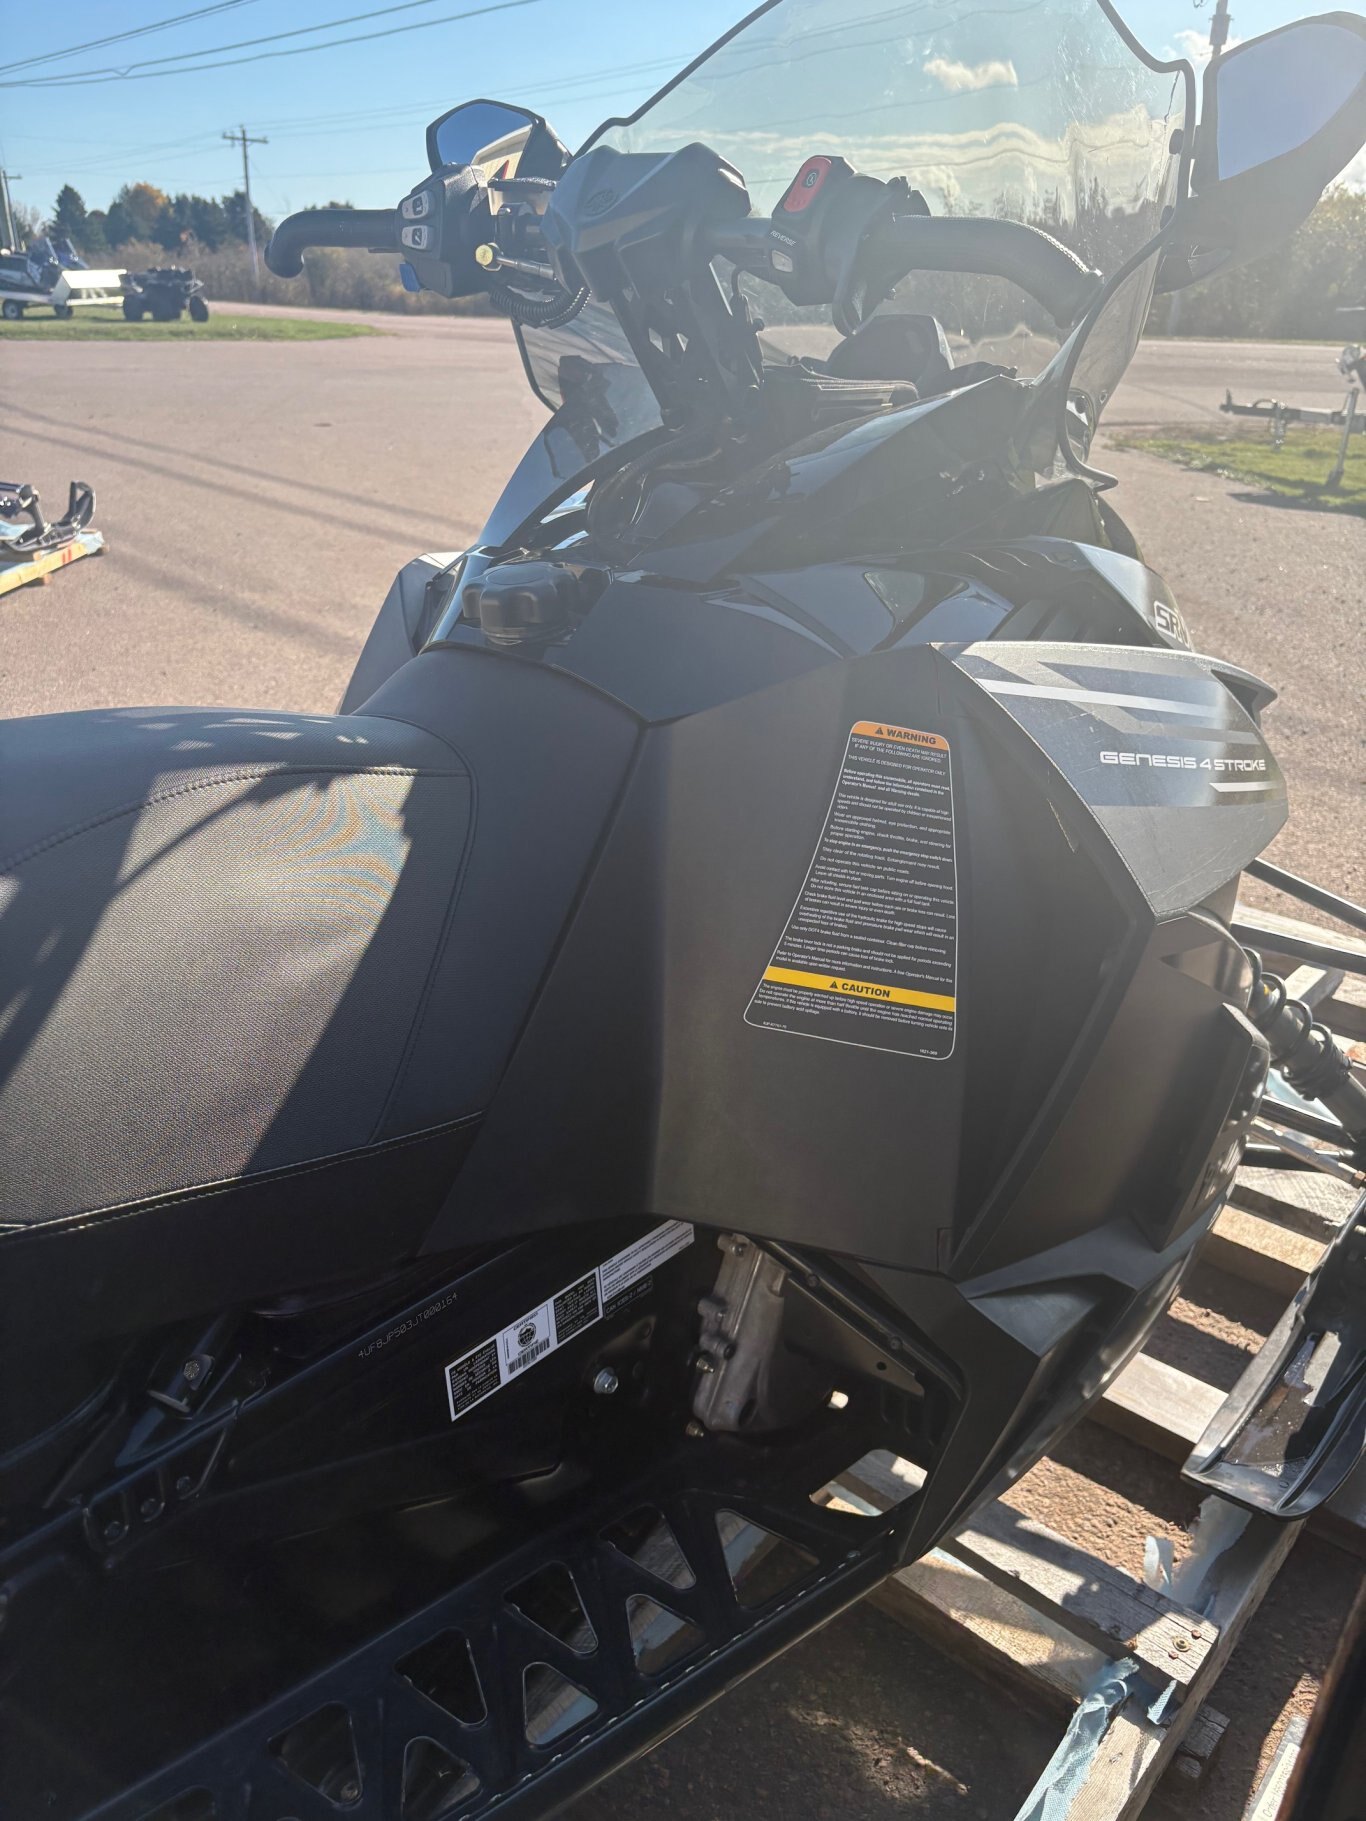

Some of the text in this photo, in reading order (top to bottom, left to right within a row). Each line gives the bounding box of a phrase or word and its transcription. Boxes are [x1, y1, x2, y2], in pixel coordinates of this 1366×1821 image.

[770, 230, 796, 246] REVERSE
[887, 728, 936, 745] WARNING
[1100, 751, 1266, 771] GENESIS 4 STROKE
[841, 983, 890, 998] CAUTION
